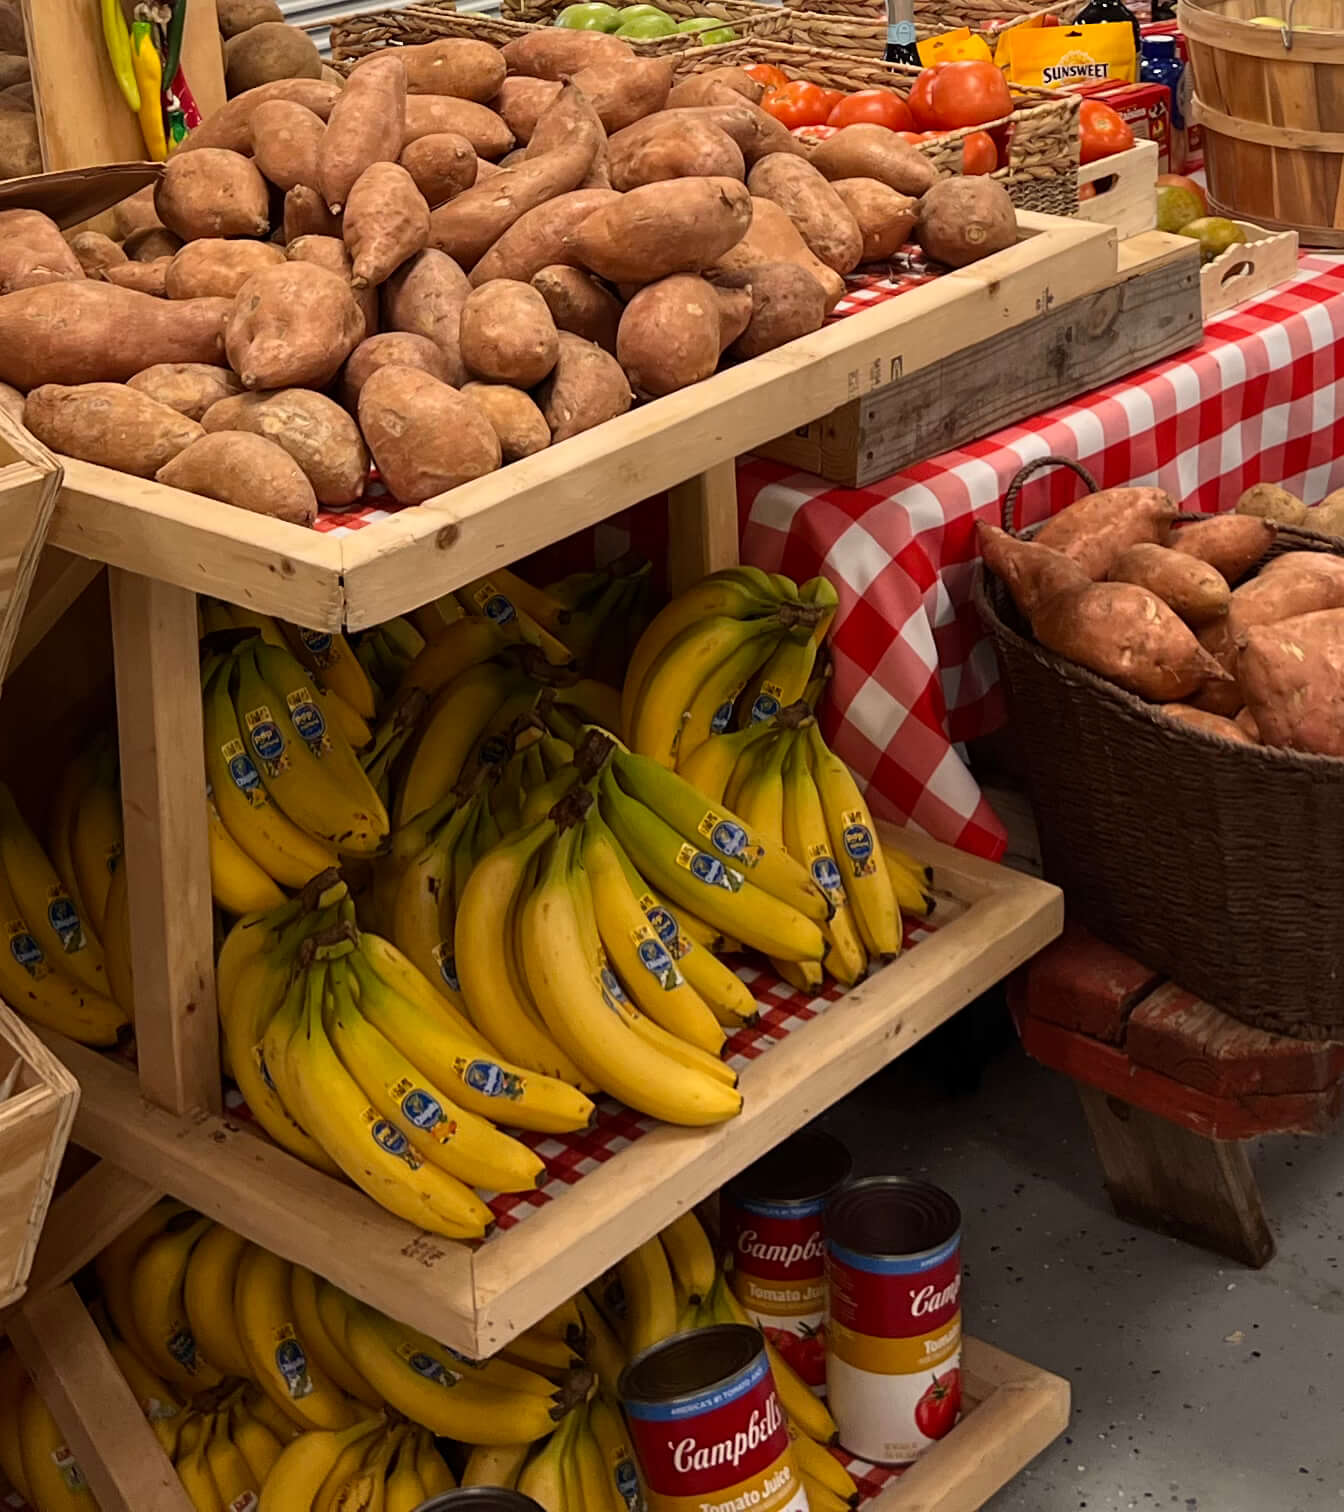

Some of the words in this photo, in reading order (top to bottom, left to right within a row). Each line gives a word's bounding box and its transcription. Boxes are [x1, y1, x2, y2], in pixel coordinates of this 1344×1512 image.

[1042, 62, 1110, 85] SUNSWEET
[749, 1283, 801, 1303] Tomato
[762, 1466, 791, 1498] Juice
